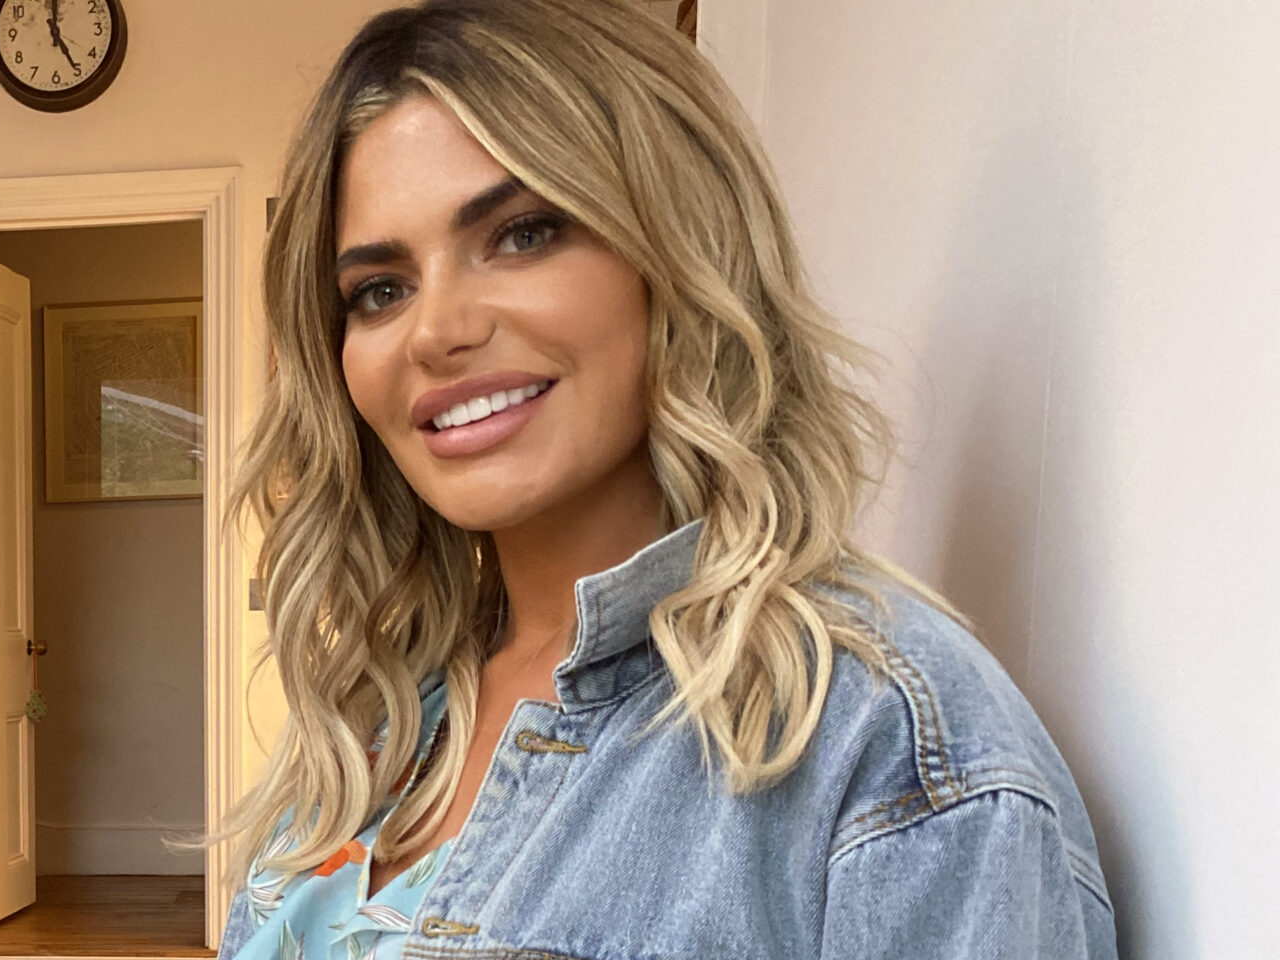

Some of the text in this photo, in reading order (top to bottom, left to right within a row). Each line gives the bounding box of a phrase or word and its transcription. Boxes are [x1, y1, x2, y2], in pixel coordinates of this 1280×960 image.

[13, 5, 25, 18] 10
[88, 0, 97, 14] 2
[8, 28, 17, 42] 9
[94, 23, 103, 36] 3
[15, 51, 23, 64] 8
[87, 47, 97, 59] 4
[30, 66, 39, 80] 7
[73, 63, 82, 77] 5
[51, 71, 61, 84] 6
